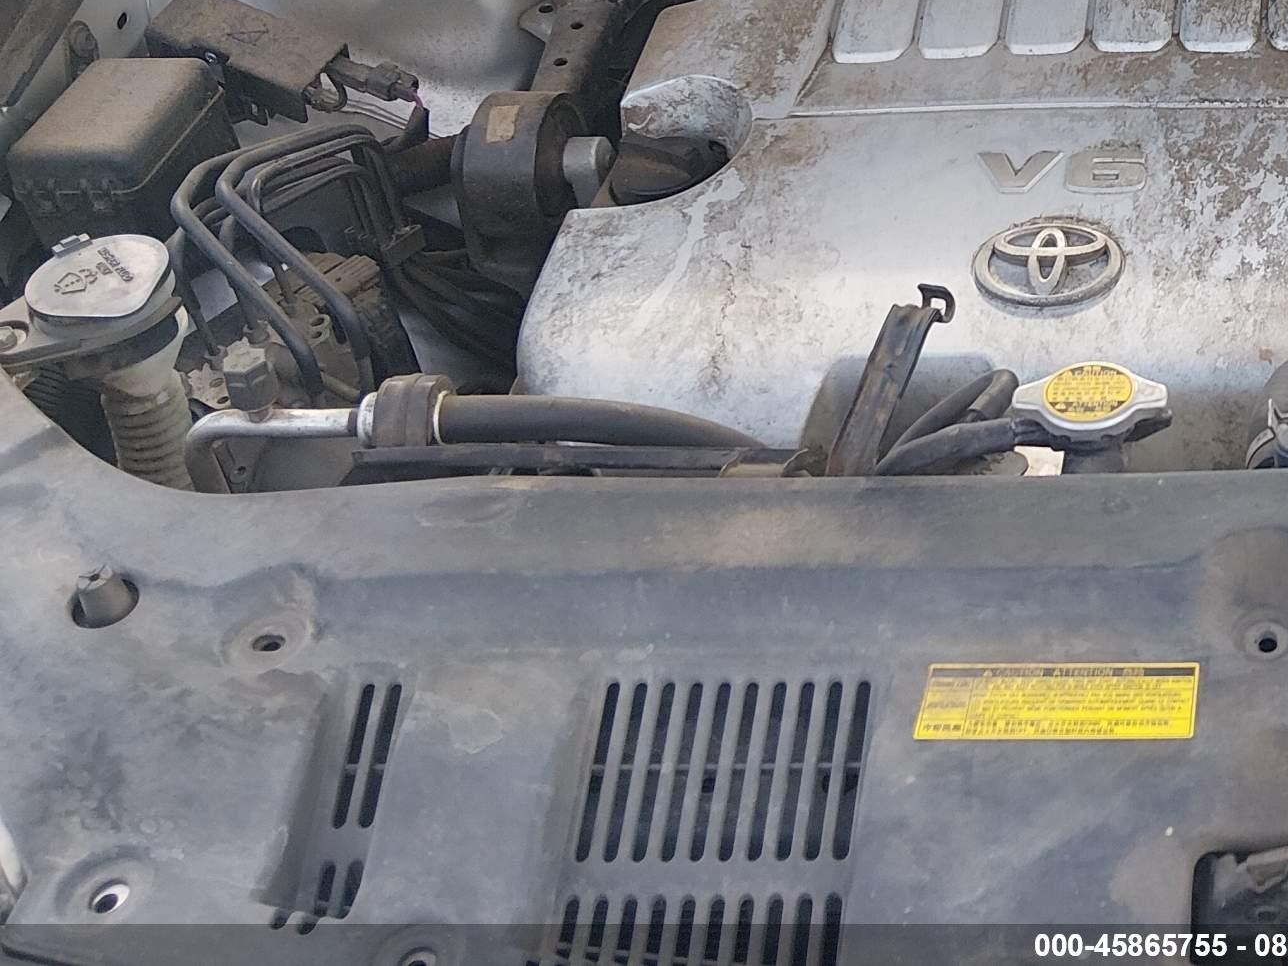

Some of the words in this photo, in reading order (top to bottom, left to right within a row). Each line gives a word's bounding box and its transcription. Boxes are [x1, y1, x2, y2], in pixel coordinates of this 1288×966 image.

[977, 149, 1148, 194] V6
[993, 667, 1044, 677] CAUTION
[1052, 667, 1113, 677] ATTENTION
